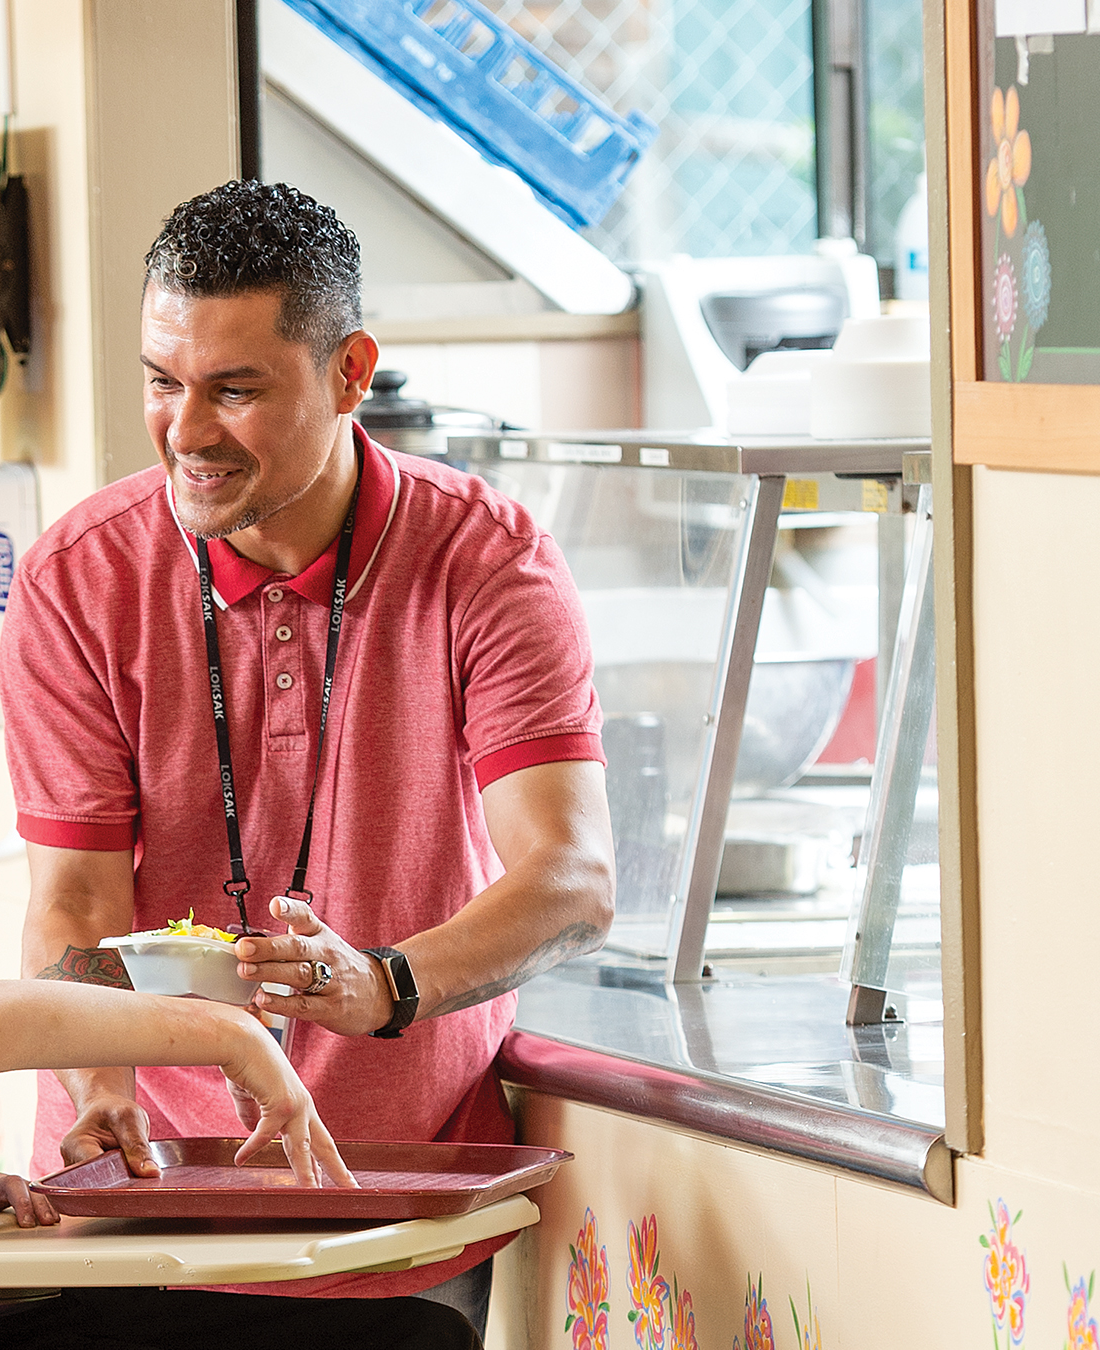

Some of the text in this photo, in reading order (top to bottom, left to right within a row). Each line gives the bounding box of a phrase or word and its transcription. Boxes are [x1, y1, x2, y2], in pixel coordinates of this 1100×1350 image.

[200, 567, 213, 621] LOKSAK
[331, 578, 346, 632] LOKSAK
[209, 666, 224, 720] LOKSAK
[321, 677, 333, 731] LOKSAK
[221, 764, 236, 818] LOKSAK
